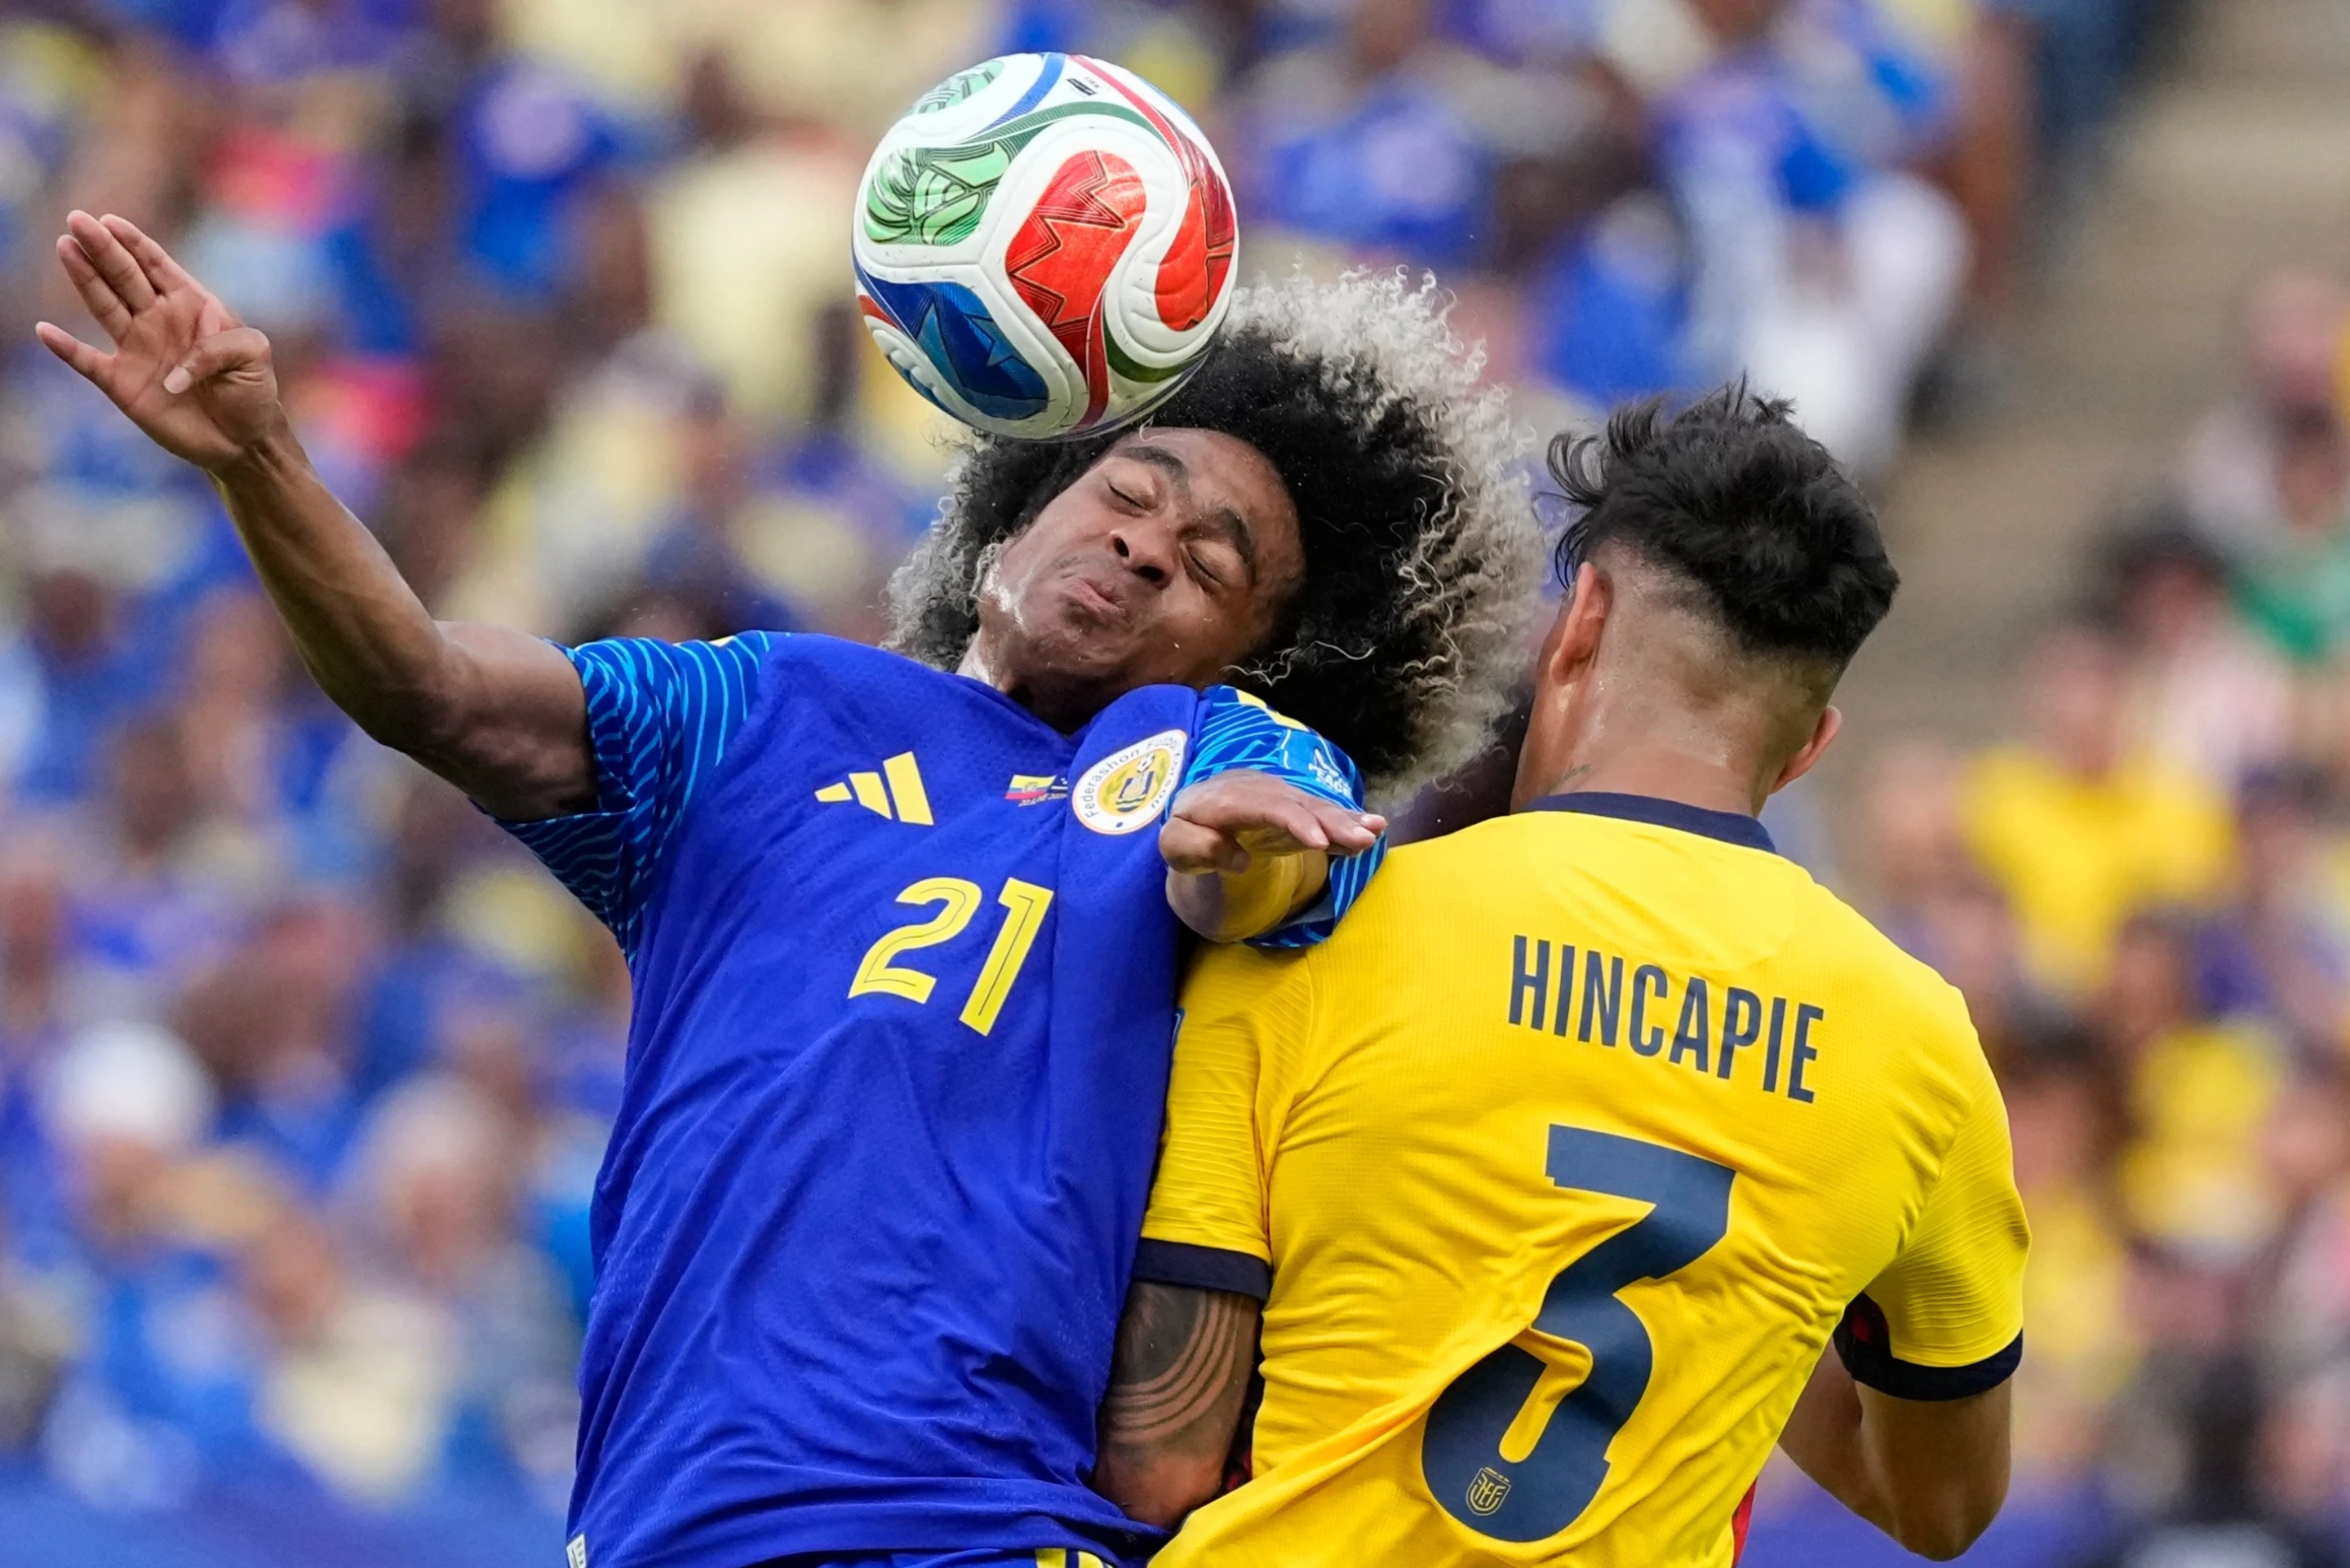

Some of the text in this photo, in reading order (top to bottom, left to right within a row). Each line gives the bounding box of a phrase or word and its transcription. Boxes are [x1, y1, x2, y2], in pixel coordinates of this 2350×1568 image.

[1080, 748, 1139, 817] Federashon
[847, 877, 1054, 1037] 21
[1509, 935, 1824, 1103] HINCAPIE
[1421, 1123, 1736, 1543] 3
